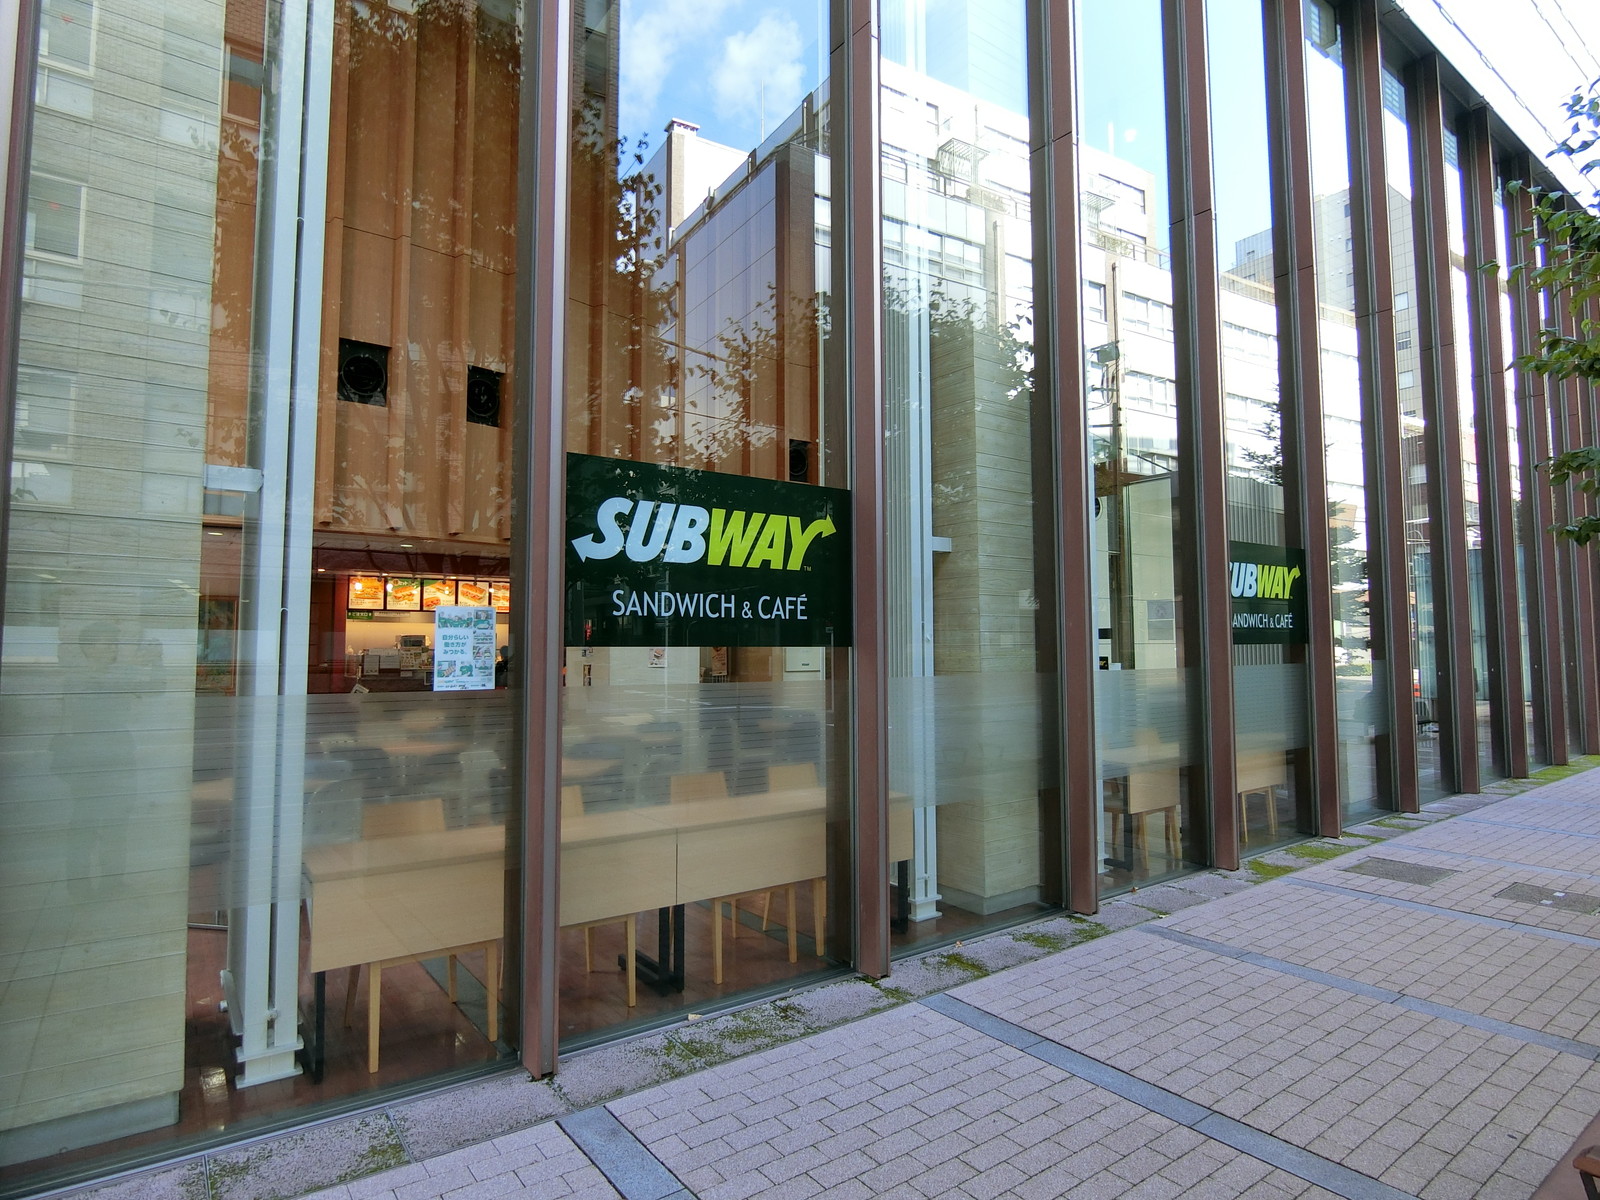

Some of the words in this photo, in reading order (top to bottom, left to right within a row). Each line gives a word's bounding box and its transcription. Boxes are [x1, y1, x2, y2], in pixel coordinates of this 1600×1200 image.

[571, 496, 837, 571] SUBWAY
[1229, 561, 1301, 599] UBWAY
[612, 589, 735, 618] SANDWICH
[741, 601, 753, 619] &
[758, 593, 808, 620] CAFÉ
[1232, 612, 1268, 628] ANDWICH
[1270, 617, 1274, 628] &
[1275, 612, 1293, 628] CAFÉ
